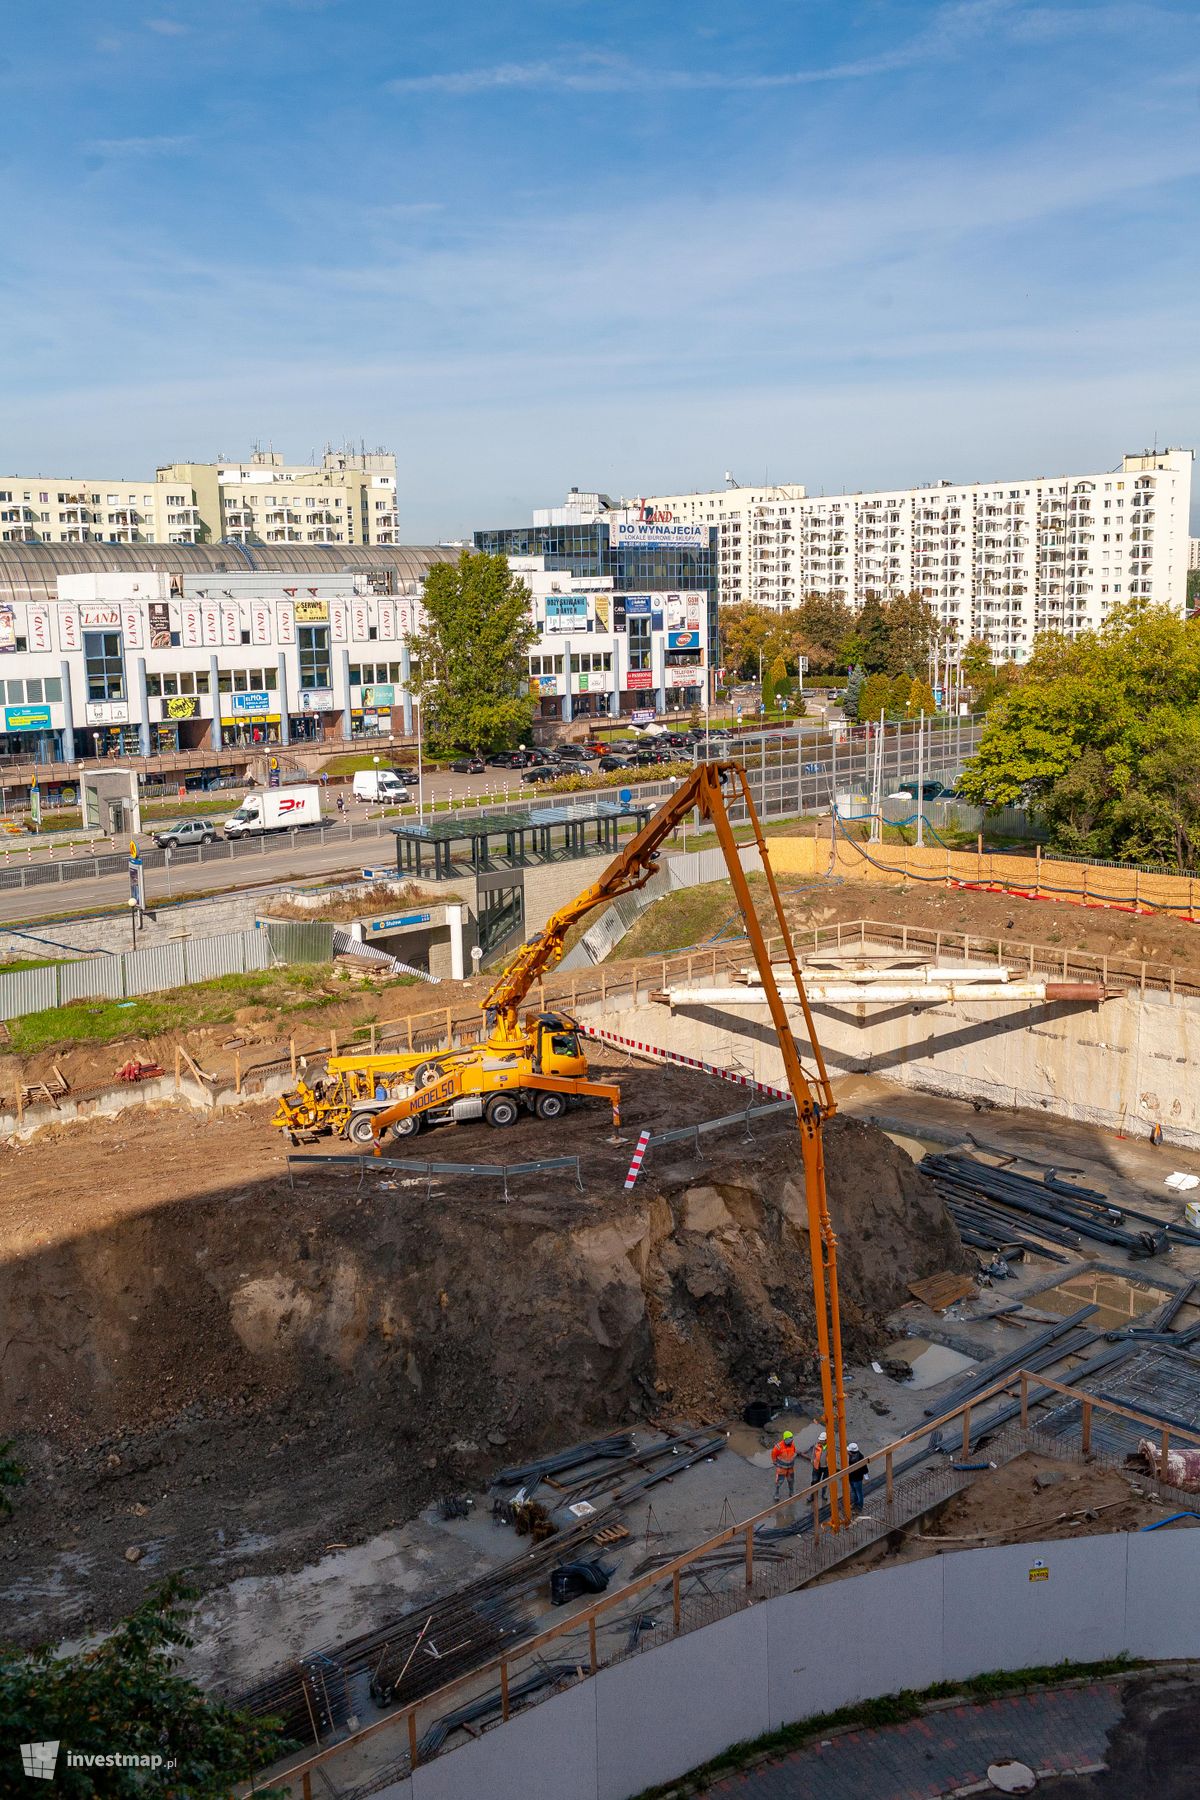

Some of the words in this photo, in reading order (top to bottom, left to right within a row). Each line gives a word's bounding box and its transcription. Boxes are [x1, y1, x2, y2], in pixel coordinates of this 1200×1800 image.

[636, 497, 673, 522] LAND
[619, 524, 635, 534] DO
[84, 612, 118, 624] LAND
[300, 601, 322, 609] SERWIS
[34, 616, 45, 648] LAND
[65, 615, 75, 647] LAND
[127, 614, 138, 645] LAND
[187, 613, 197, 643] LAND
[207, 613, 217, 642] LAND
[227, 612, 236, 641] LAND
[257, 612, 266, 641] LAND
[282, 612, 290, 640] LAND
[334, 610, 343, 638] LAND
[356, 609, 365, 637] LAND
[383, 610, 391, 637] LAND
